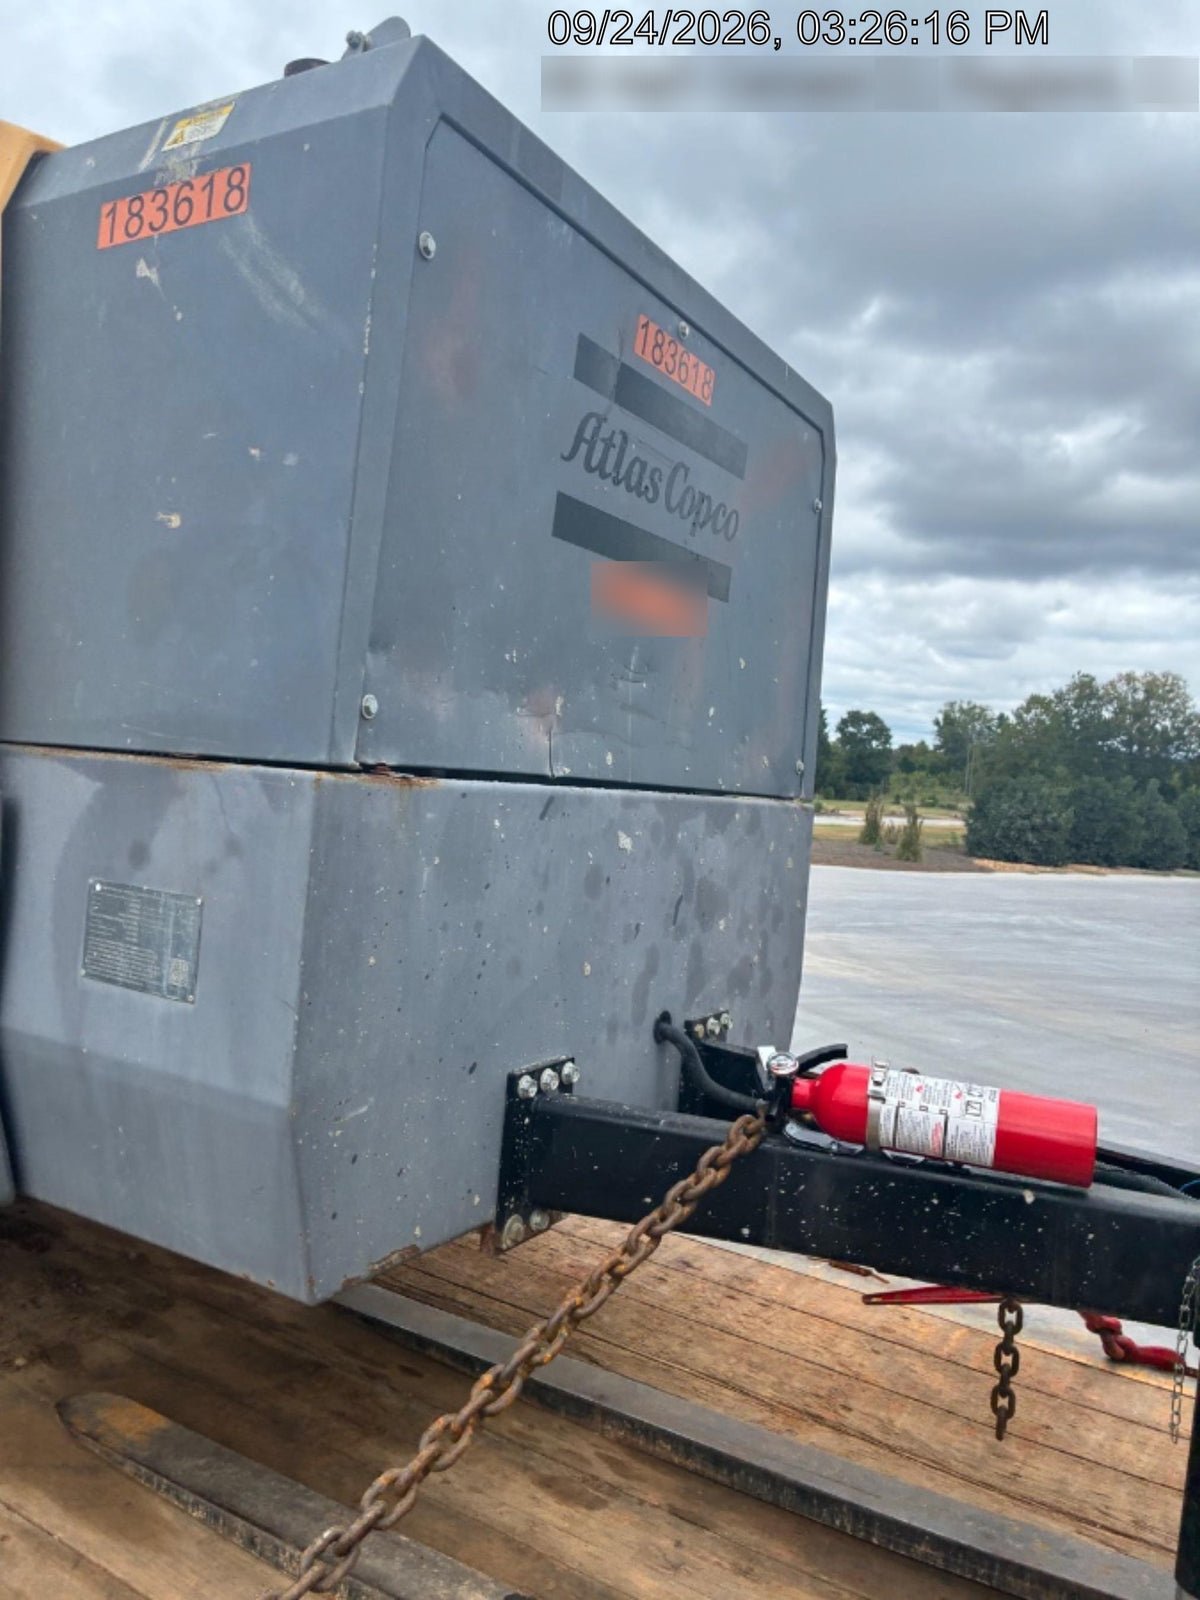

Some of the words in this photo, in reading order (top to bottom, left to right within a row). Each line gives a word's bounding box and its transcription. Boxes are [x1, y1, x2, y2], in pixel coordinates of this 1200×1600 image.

[106, 167, 246, 243] 183618
[639, 319, 714, 400] 183618
[560, 411, 663, 504] Atlas
[664, 462, 740, 542] Copco
